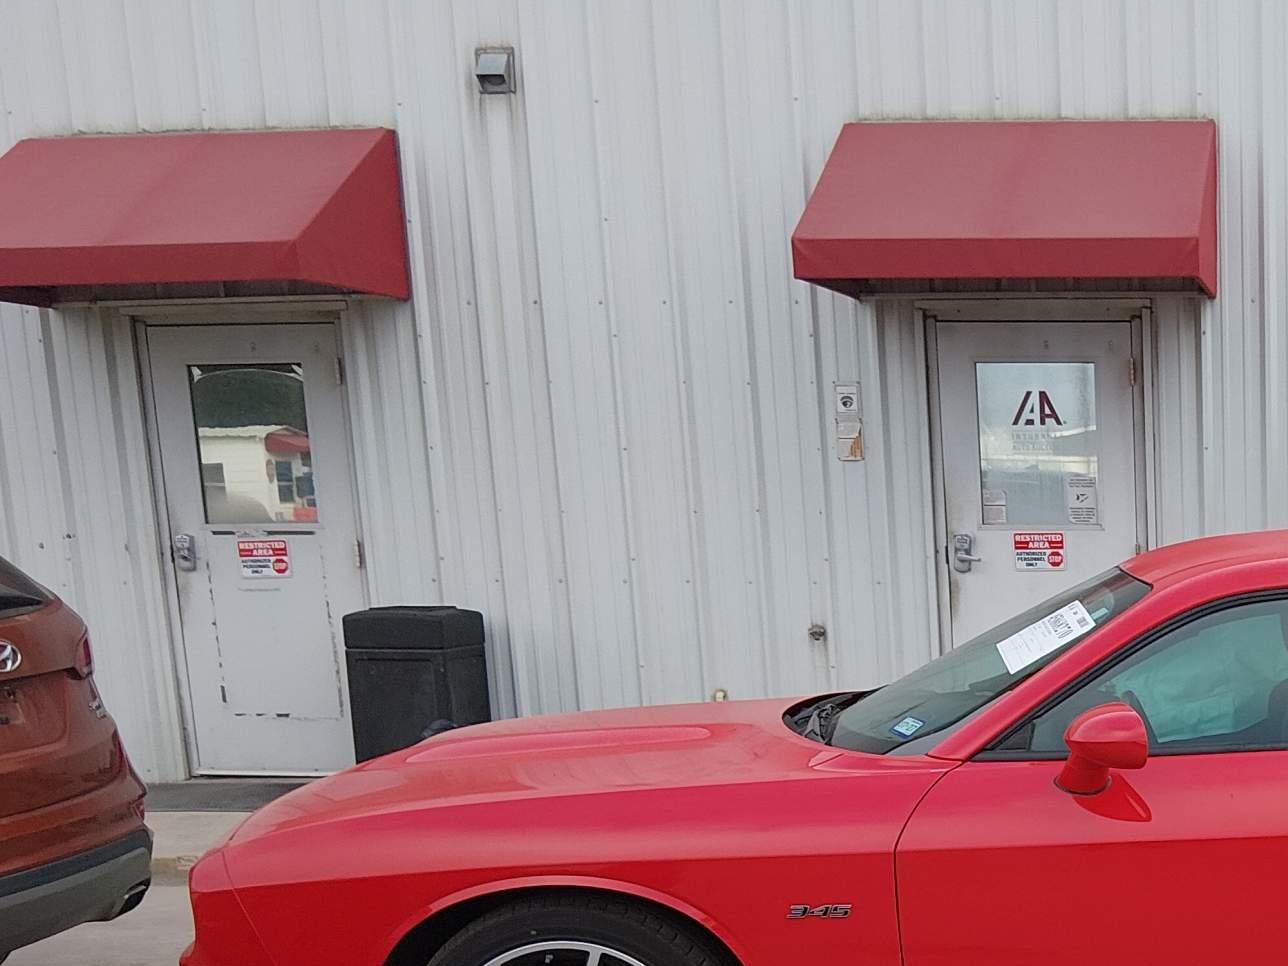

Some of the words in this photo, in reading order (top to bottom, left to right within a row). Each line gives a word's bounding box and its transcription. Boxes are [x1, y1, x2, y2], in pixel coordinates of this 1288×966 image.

[1028, 541, 1050, 549] AREA
[1049, 555, 1062, 563] STOP
[785, 904, 852, 919] 345
